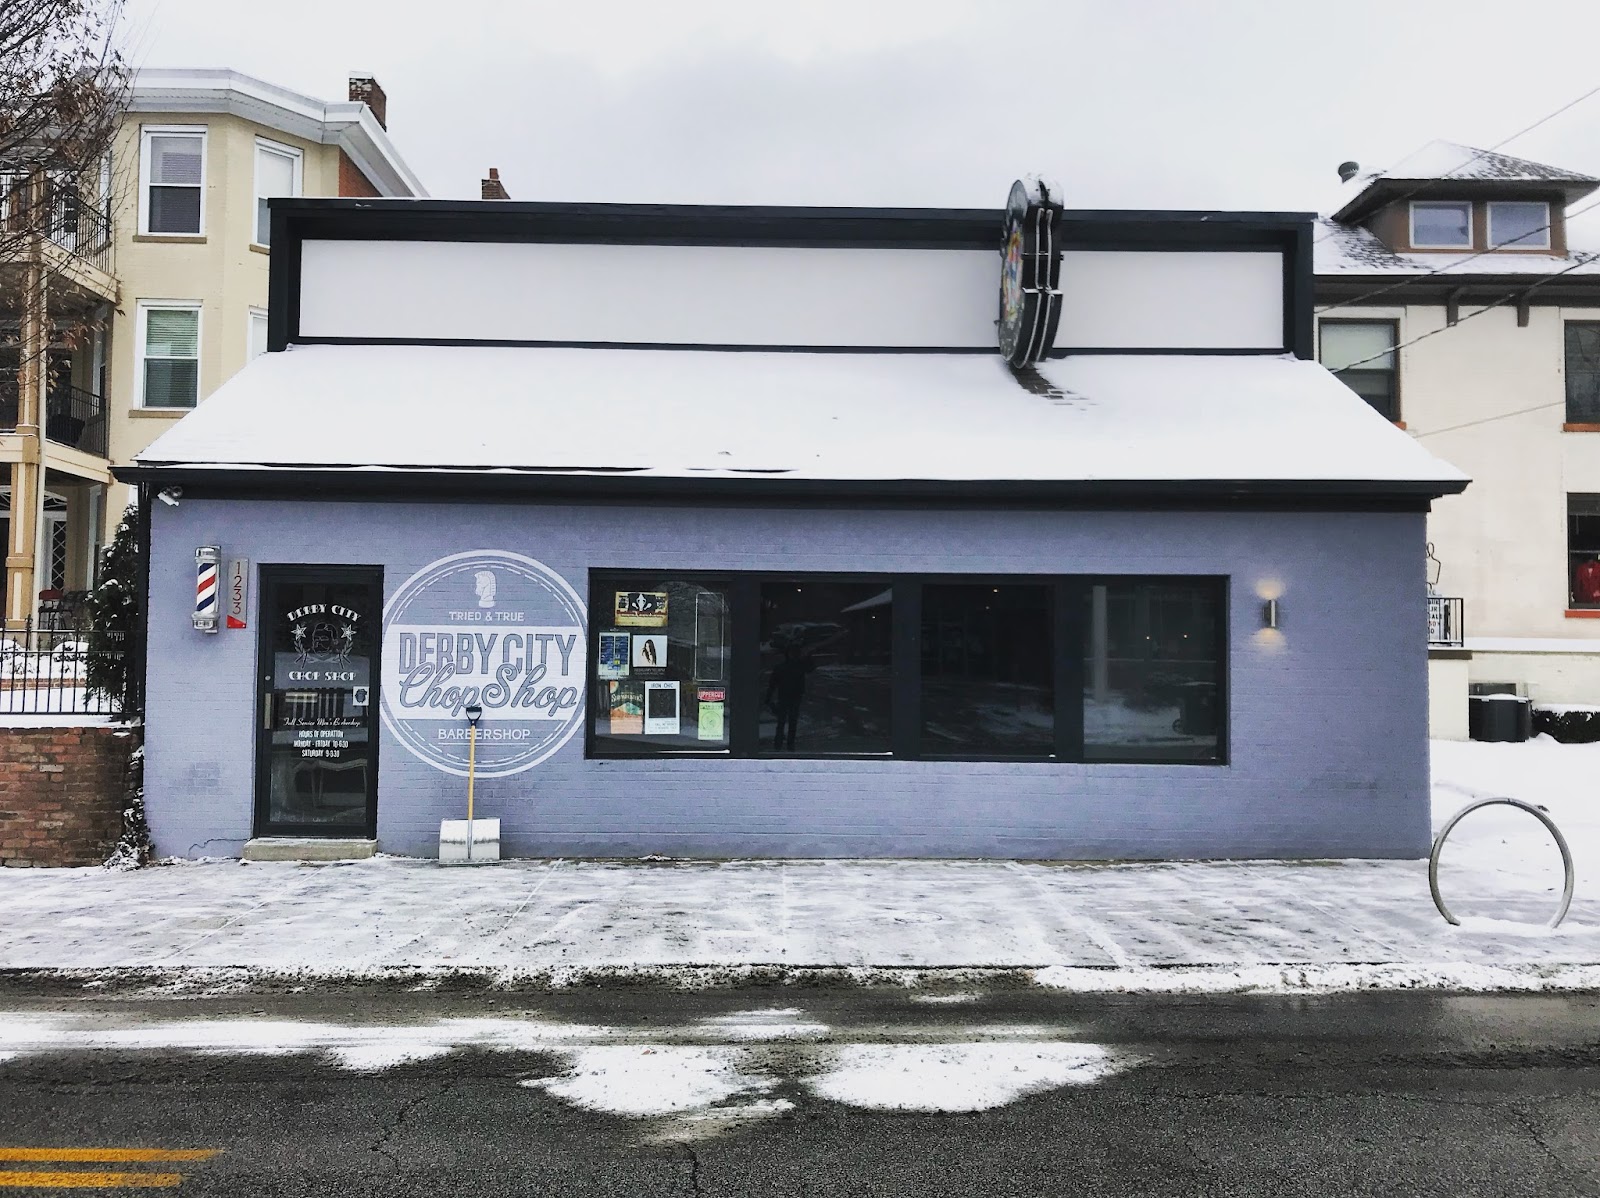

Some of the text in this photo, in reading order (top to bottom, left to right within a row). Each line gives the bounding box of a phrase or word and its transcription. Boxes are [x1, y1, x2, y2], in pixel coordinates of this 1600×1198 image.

[232, 561, 243, 615] 1233
[286, 603, 361, 622] DERBY CITY
[449, 611, 525, 622] TRIED & TRUE
[398, 632, 499, 675] DERBY
[502, 633, 577, 676] CITY
[288, 671, 357, 681] CHOP SHOP
[398, 661, 578, 718] Chop Shop
[283, 717, 297, 726] Full
[296, 717, 316, 726] Service
[298, 730, 344, 739] HOURS OF OPERATION
[437, 728, 532, 741] BARBERSHOP
[293, 740, 312, 748] MONDAY
[315, 740, 331, 748] FRIDAY
[301, 749, 324, 758] SATURDAY
